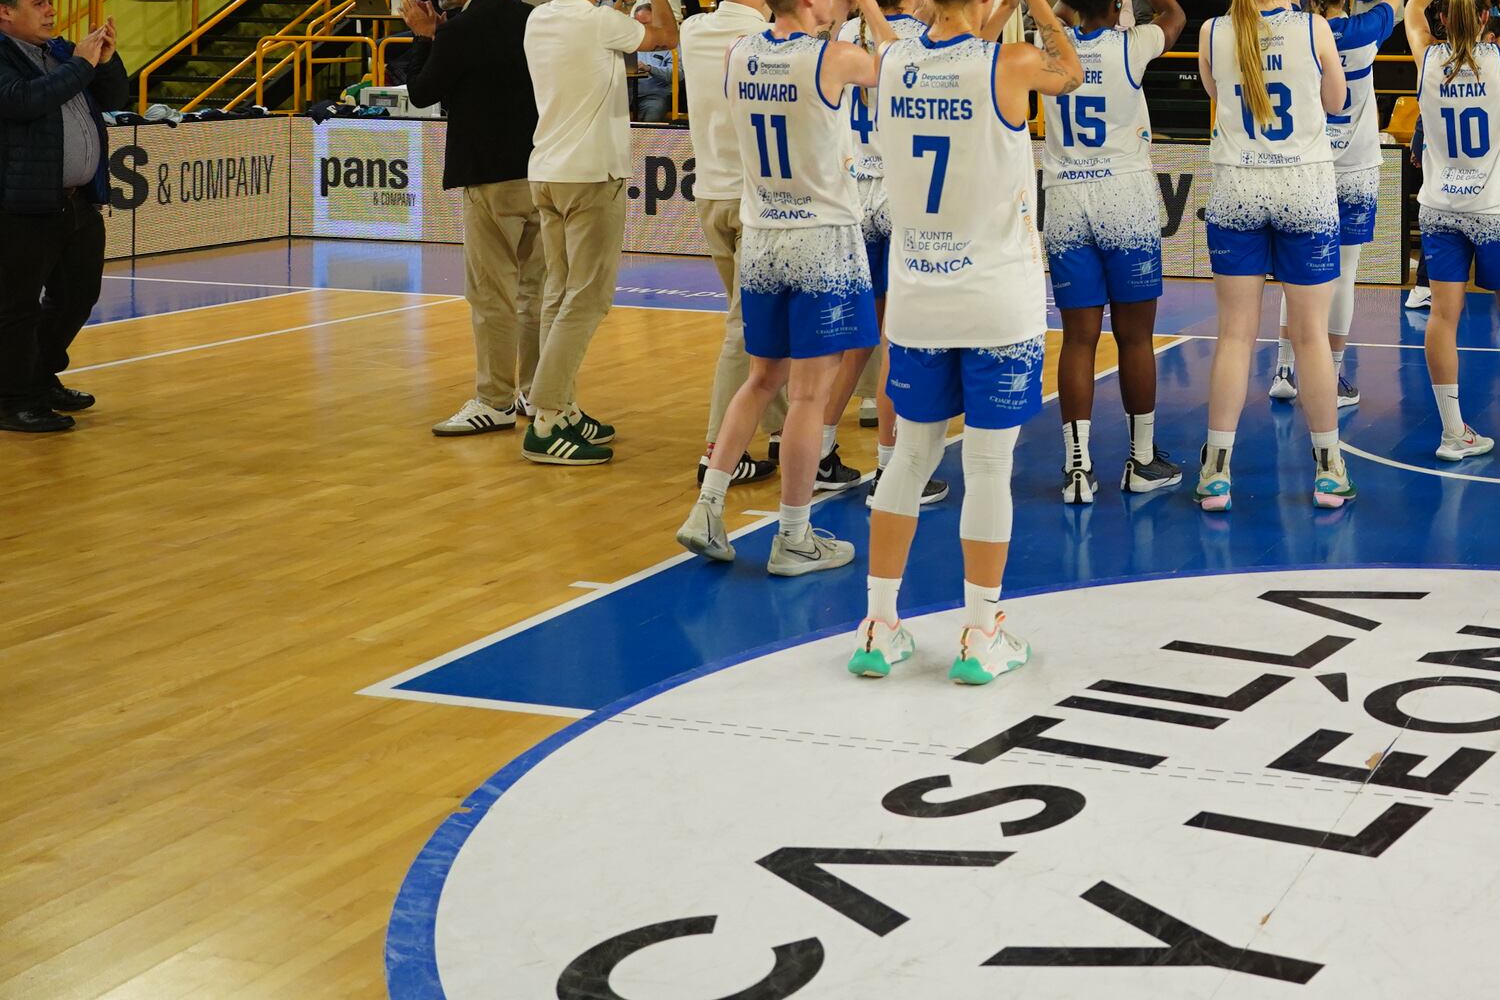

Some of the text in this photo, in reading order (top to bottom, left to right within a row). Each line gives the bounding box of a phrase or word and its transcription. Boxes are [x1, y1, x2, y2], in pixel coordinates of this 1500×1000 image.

[739, 82, 797, 102] HOWARD
[921, 73, 959, 82] Deputación
[1440, 83, 1486, 98] MATAIX
[891, 96, 972, 120] MESTRES
[1056, 95, 1106, 147] 15
[1235, 82, 1293, 141] 13
[751, 113, 792, 179] 11
[1441, 107, 1490, 158] 10
[157, 154, 274, 205] & COMPANY
[321, 156, 409, 197] pans
[913, 135, 950, 213] 7
[1062, 169, 1112, 180] ABANCA
[380, 193, 416, 207] COMPANY
[918, 242, 931, 251] DE
[919, 231, 953, 240] XUNTA
[557, 590, 1430, 1000] CASTILLA
[981, 880, 1325, 986] Y
